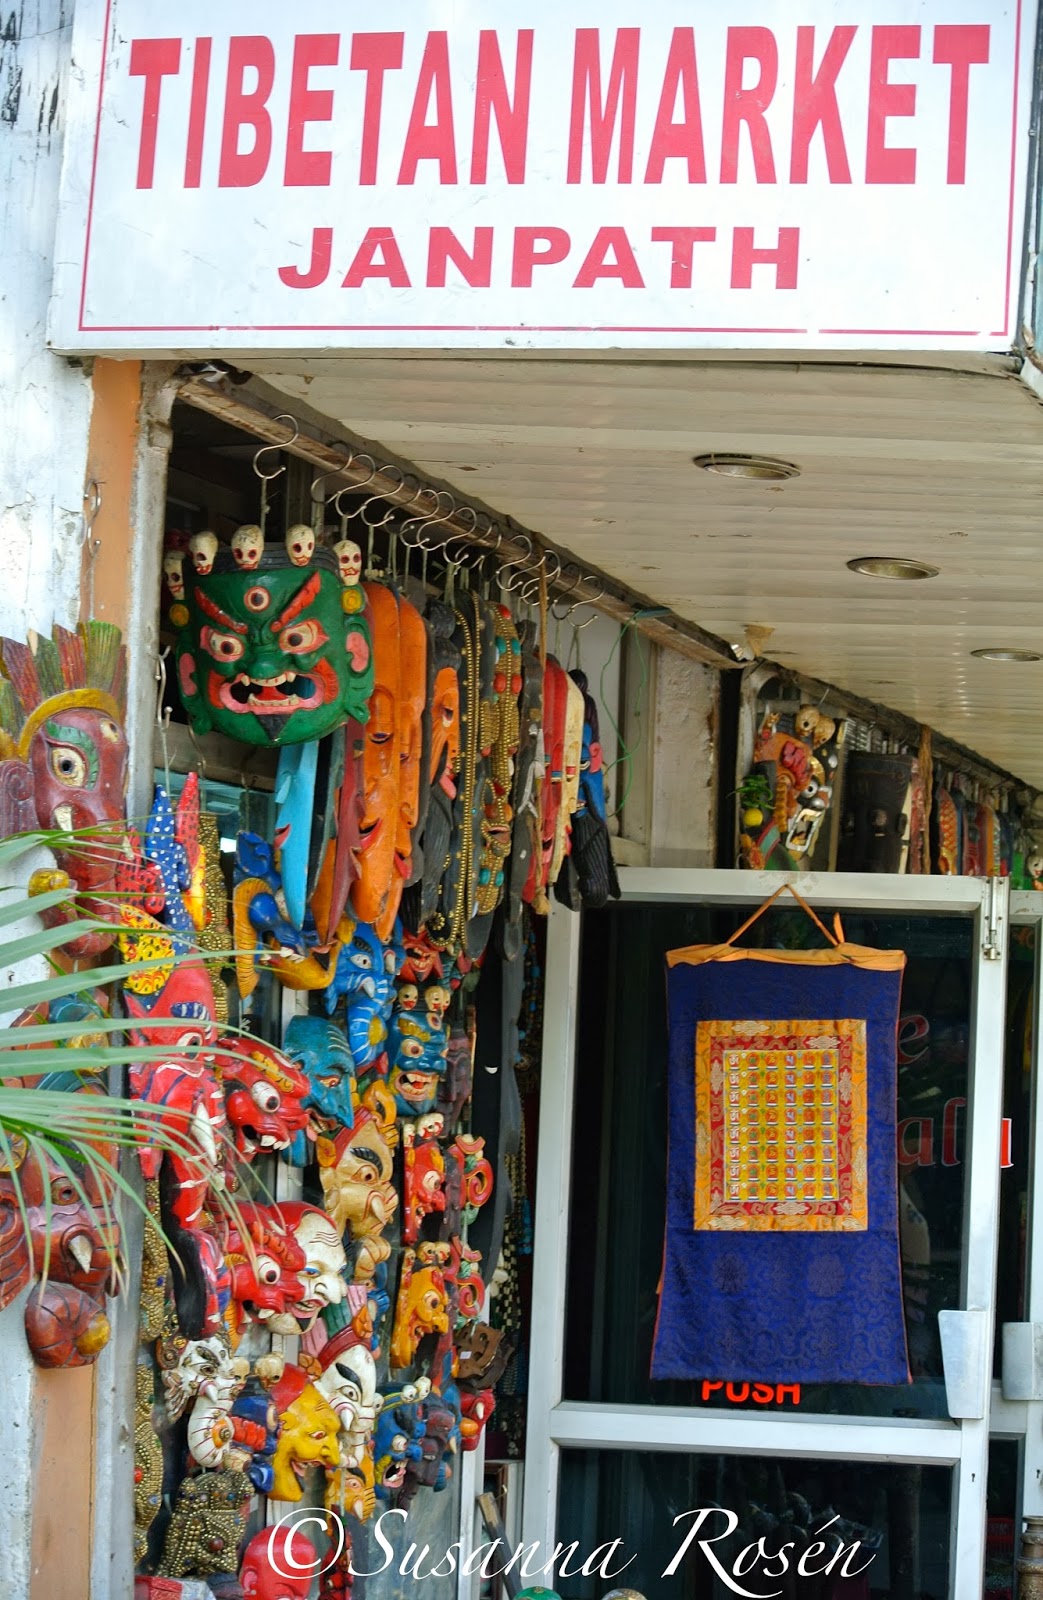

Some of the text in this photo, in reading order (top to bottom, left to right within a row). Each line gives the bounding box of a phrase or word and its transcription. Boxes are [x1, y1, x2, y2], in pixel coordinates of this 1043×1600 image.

[129, 25, 991, 189] TIBETAN MARKET
[277, 227, 801, 290] JANPATH
[702, 1380, 801, 1405] PUSH
